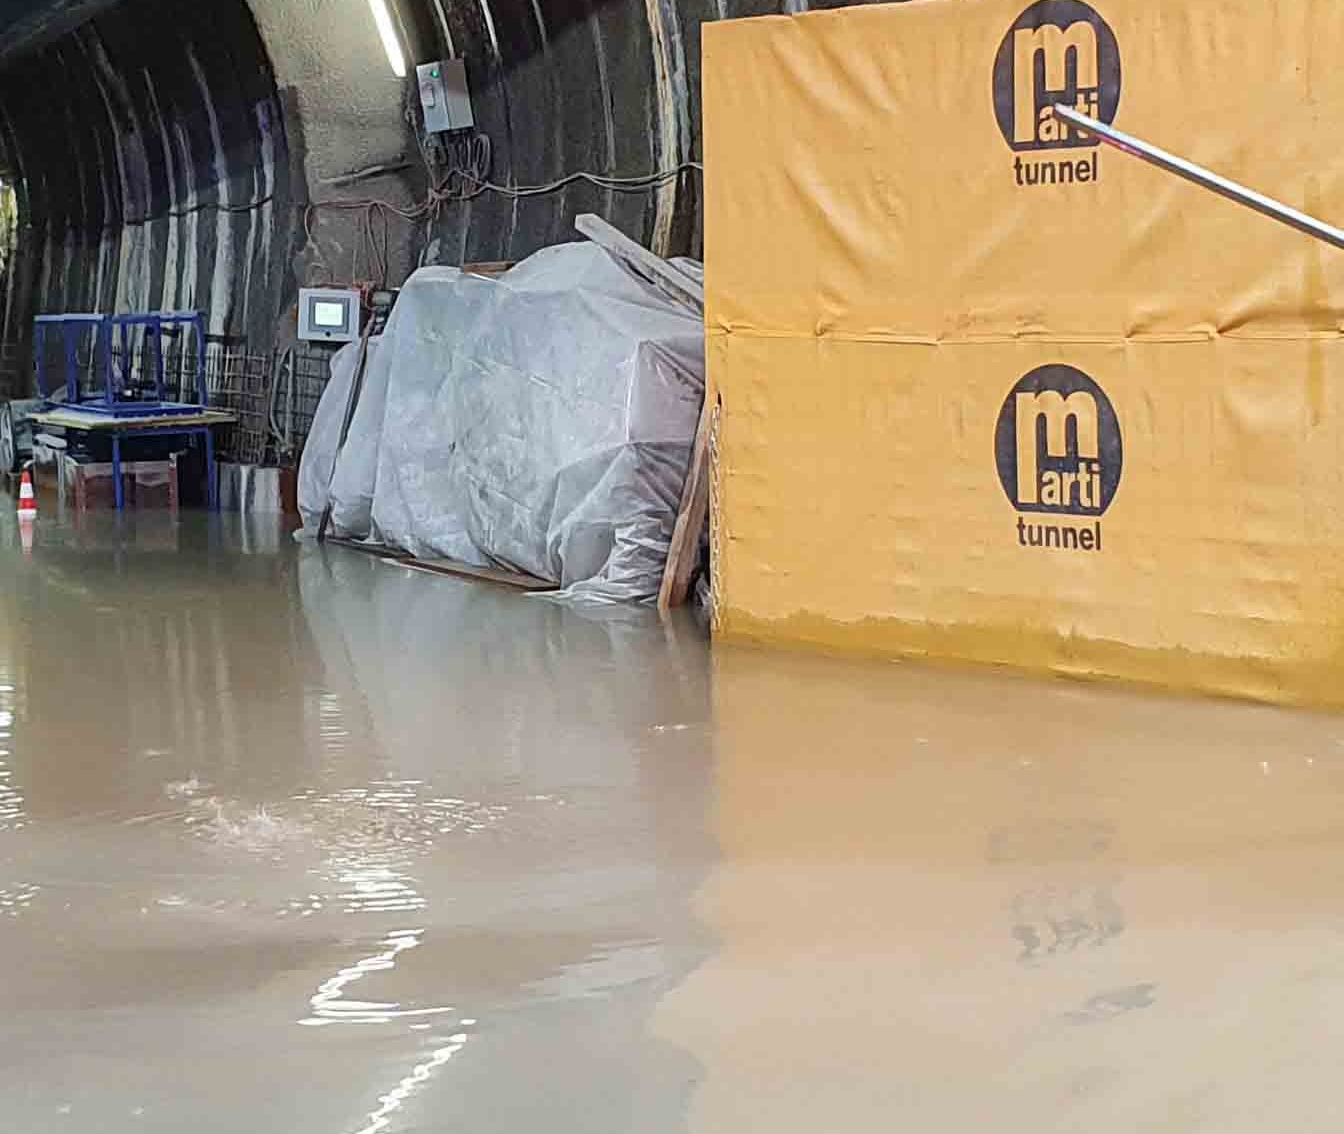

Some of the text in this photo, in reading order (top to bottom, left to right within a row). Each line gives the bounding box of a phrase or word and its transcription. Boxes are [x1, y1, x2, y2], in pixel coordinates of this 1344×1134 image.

[1013, 151, 1098, 186] tunnel
[1016, 389, 1101, 508] marti
[1017, 516, 1102, 551] tunnel
